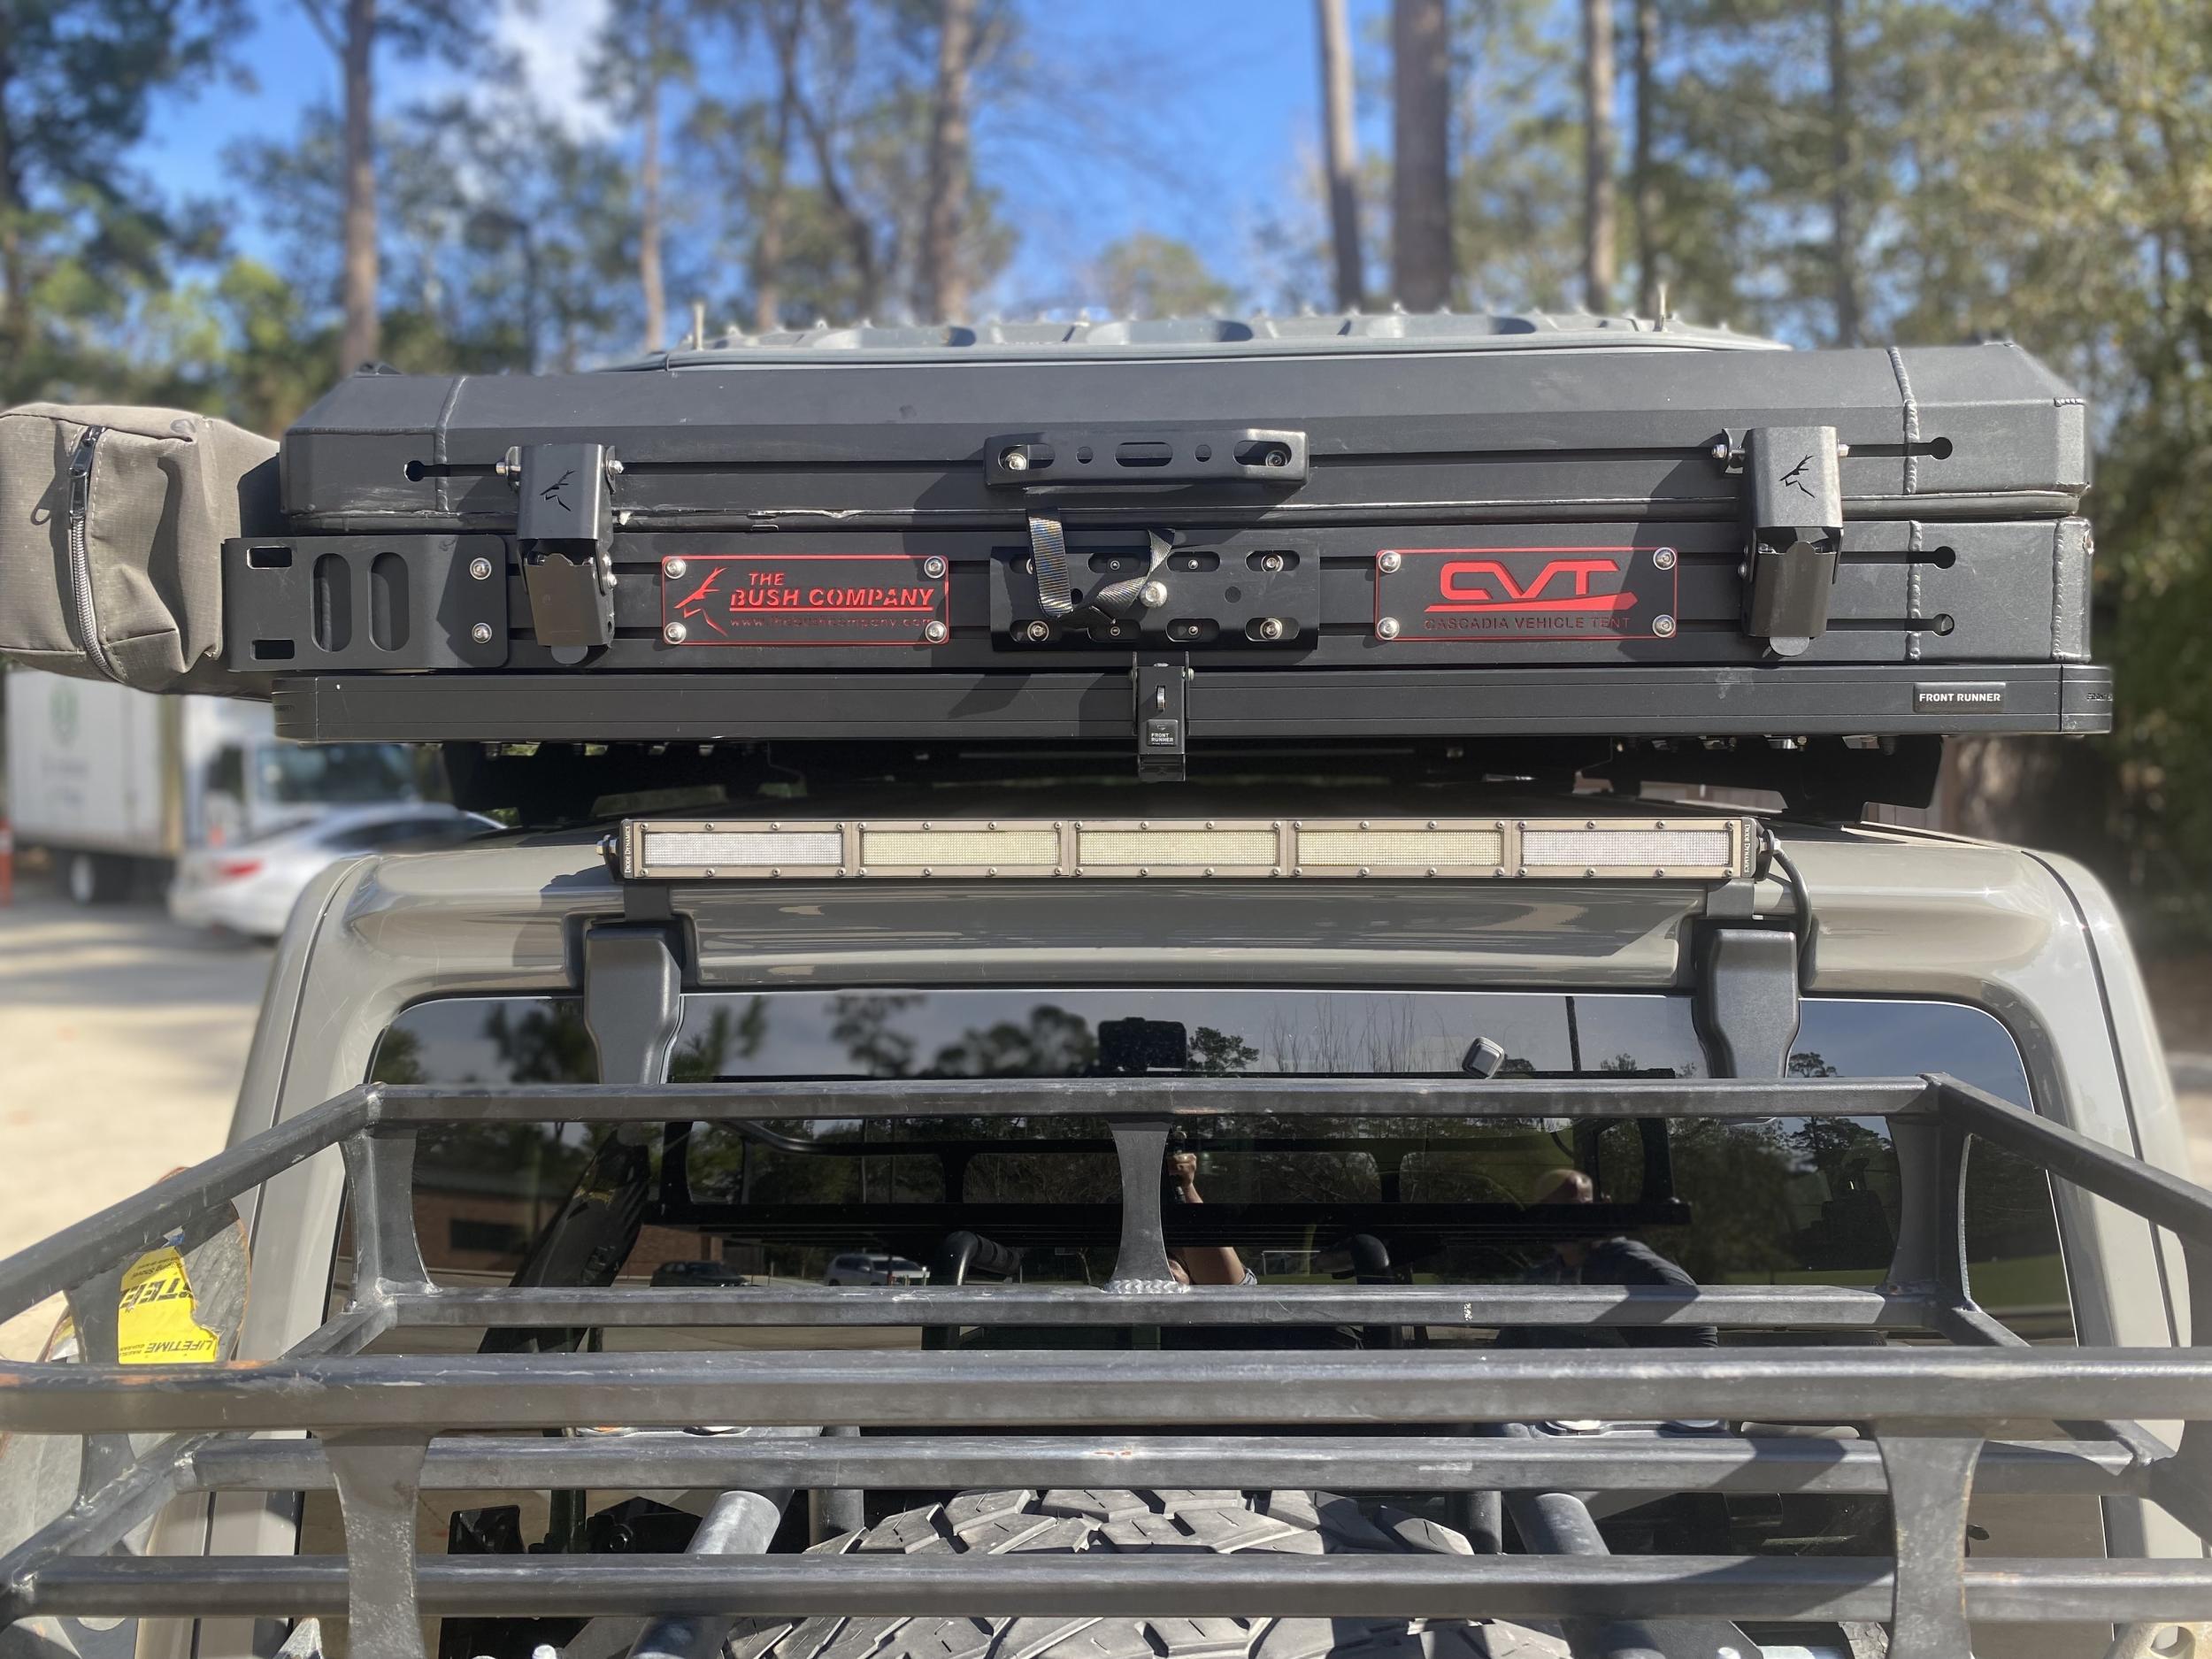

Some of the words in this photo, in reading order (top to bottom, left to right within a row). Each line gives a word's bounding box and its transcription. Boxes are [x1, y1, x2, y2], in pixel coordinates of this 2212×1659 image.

[749, 572, 786, 586] THE
[1440, 558, 1621, 601] CVT
[729, 588, 800, 606] BUSH
[809, 588, 934, 606] COMPANY
[1424, 617, 1509, 631] CASCADIA
[1514, 616, 1584, 629] VEHICLE
[1590, 616, 1630, 629] TENT
[1918, 693, 1954, 703] FRONT
[1956, 693, 2001, 703] RUNNER
[145, 1340, 213, 1354] LIFETIME
